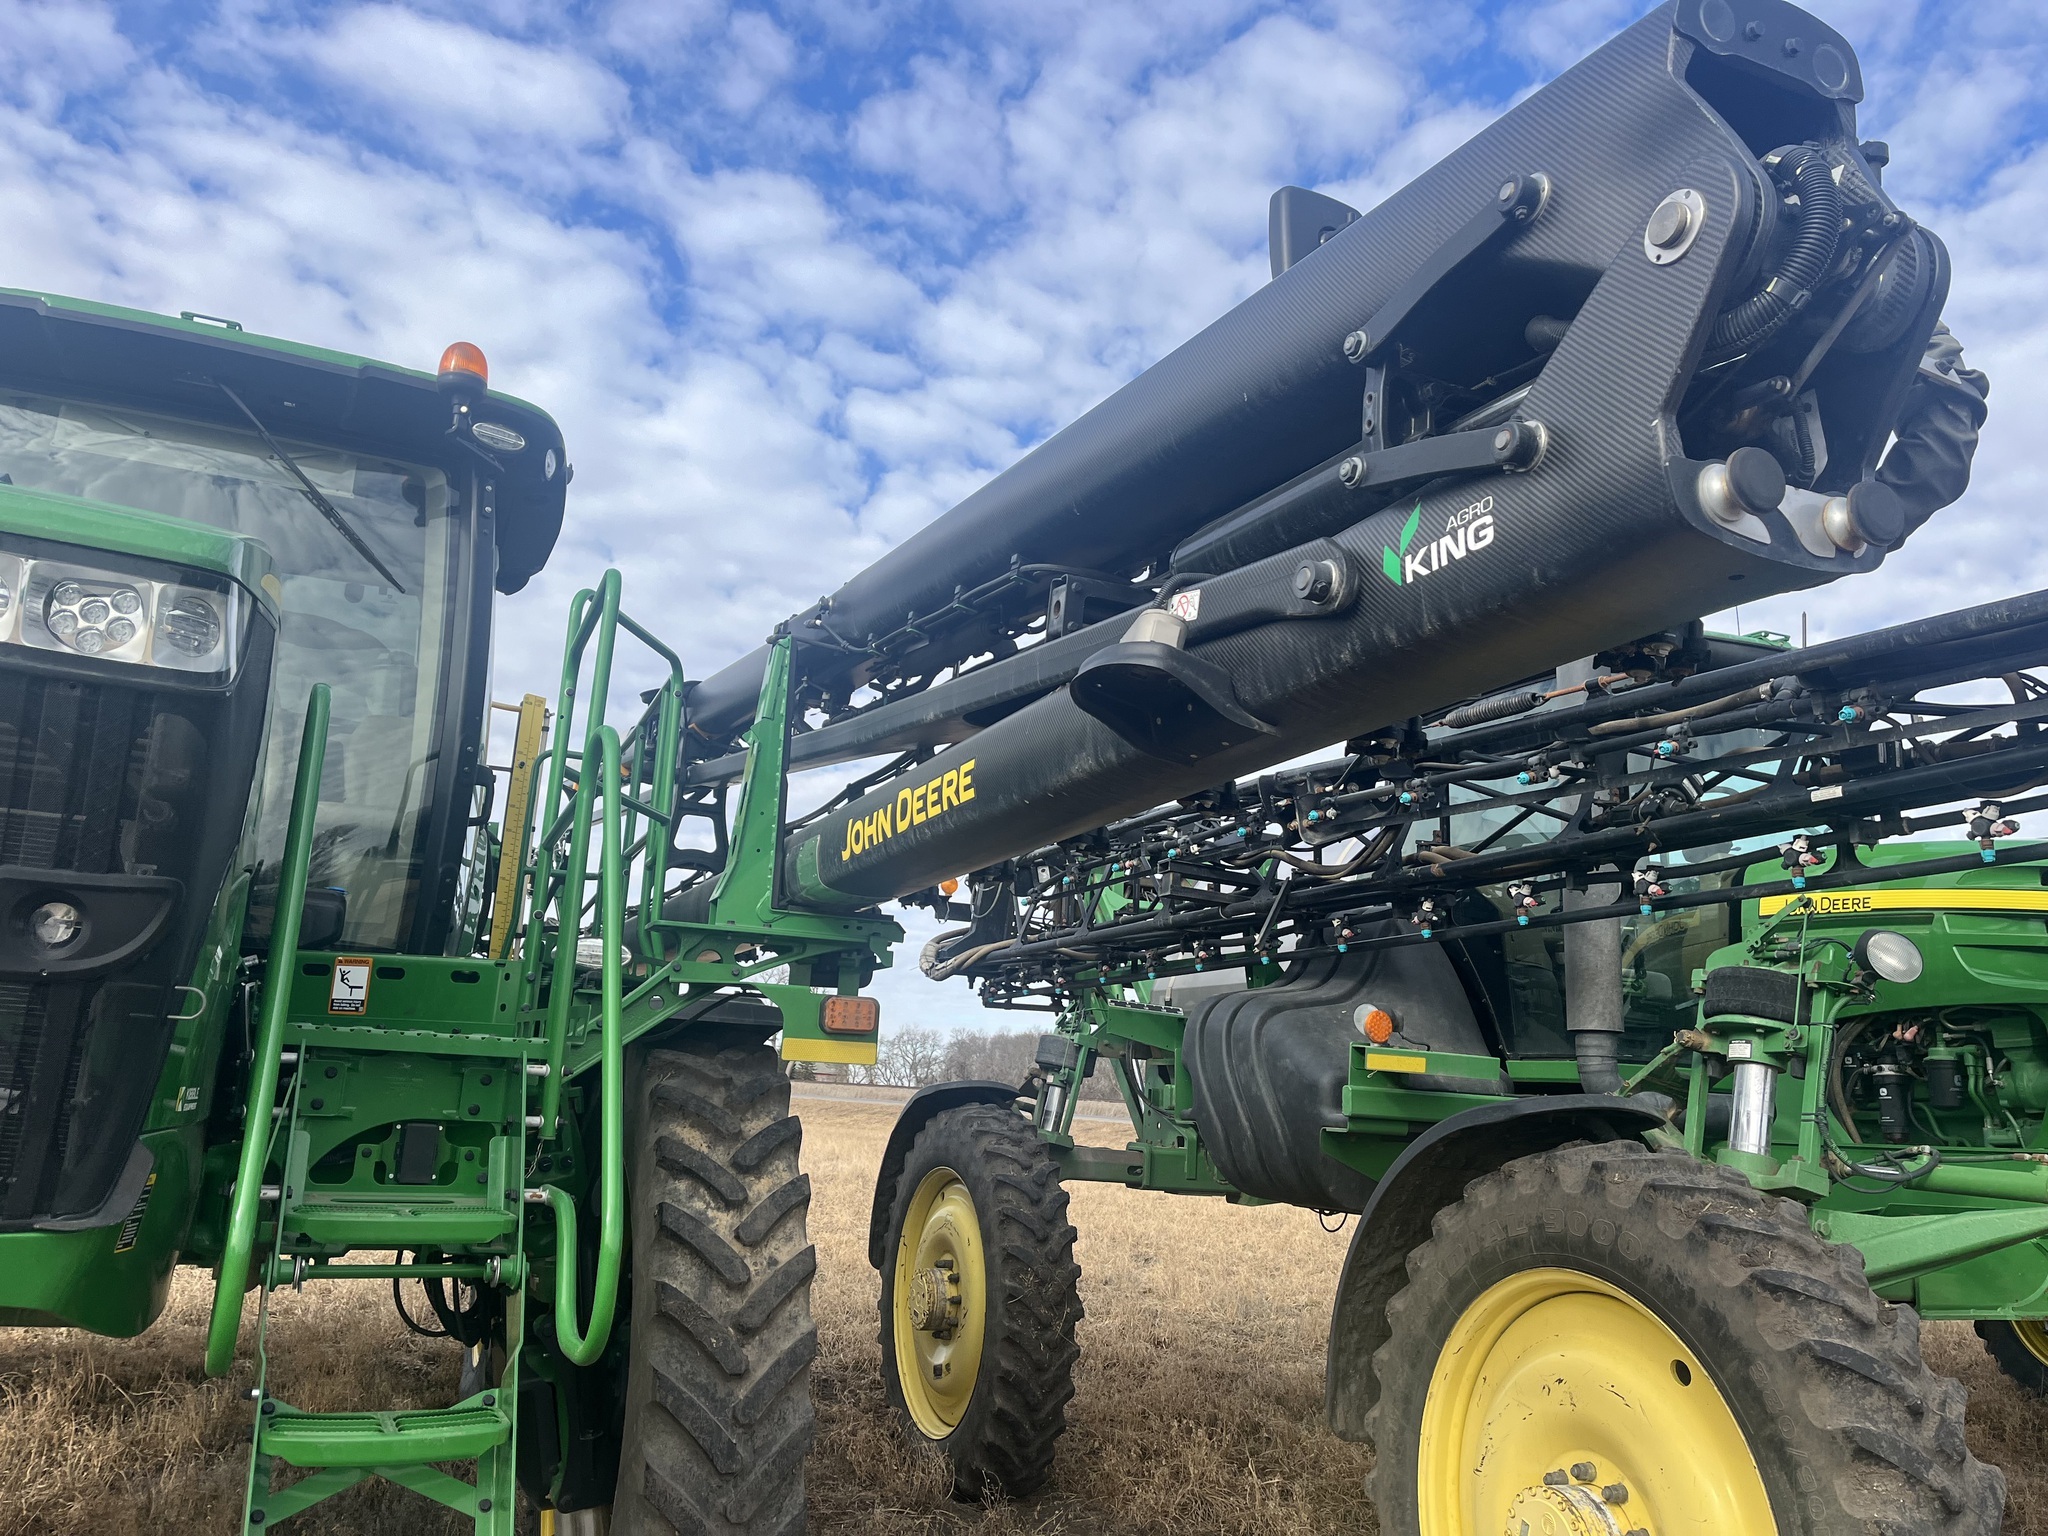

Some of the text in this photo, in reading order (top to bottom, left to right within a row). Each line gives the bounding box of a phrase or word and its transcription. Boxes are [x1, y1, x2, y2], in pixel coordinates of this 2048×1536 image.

[1445, 495, 1494, 532] AGRO
[1404, 514, 1495, 584] KING
[841, 758, 976, 861] JOHN DEERE
[1820, 896, 1871, 911] DEERE
[1543, 1208, 1643, 1261] 9000
[1751, 1361, 1831, 1536] 320/90
